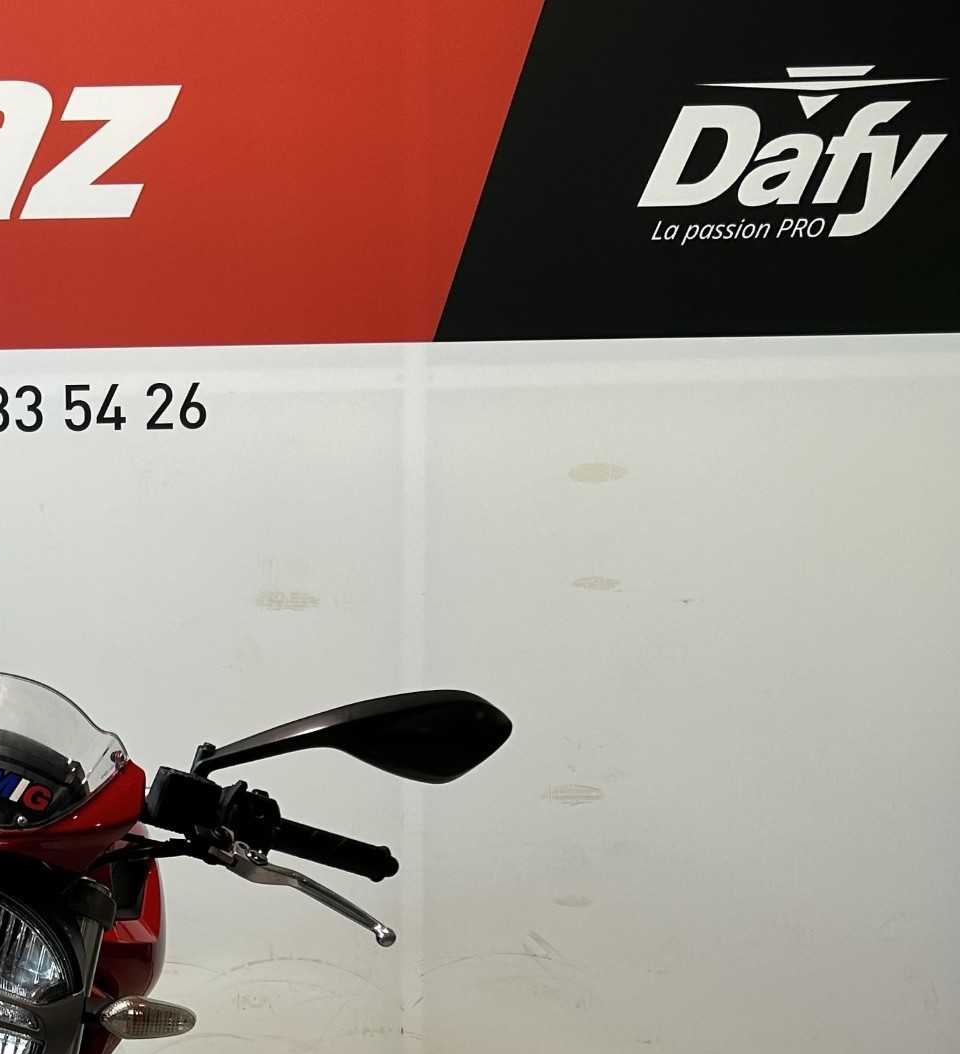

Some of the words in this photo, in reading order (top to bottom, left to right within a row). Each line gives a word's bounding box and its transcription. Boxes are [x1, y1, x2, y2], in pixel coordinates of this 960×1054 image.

[637, 101, 947, 238] Dafy
[651, 220, 679, 240] La
[681, 219, 770, 246] passion
[776, 218, 826, 239] PRO
[64, 383, 127, 432] 54
[146, 382, 207, 430] 26
